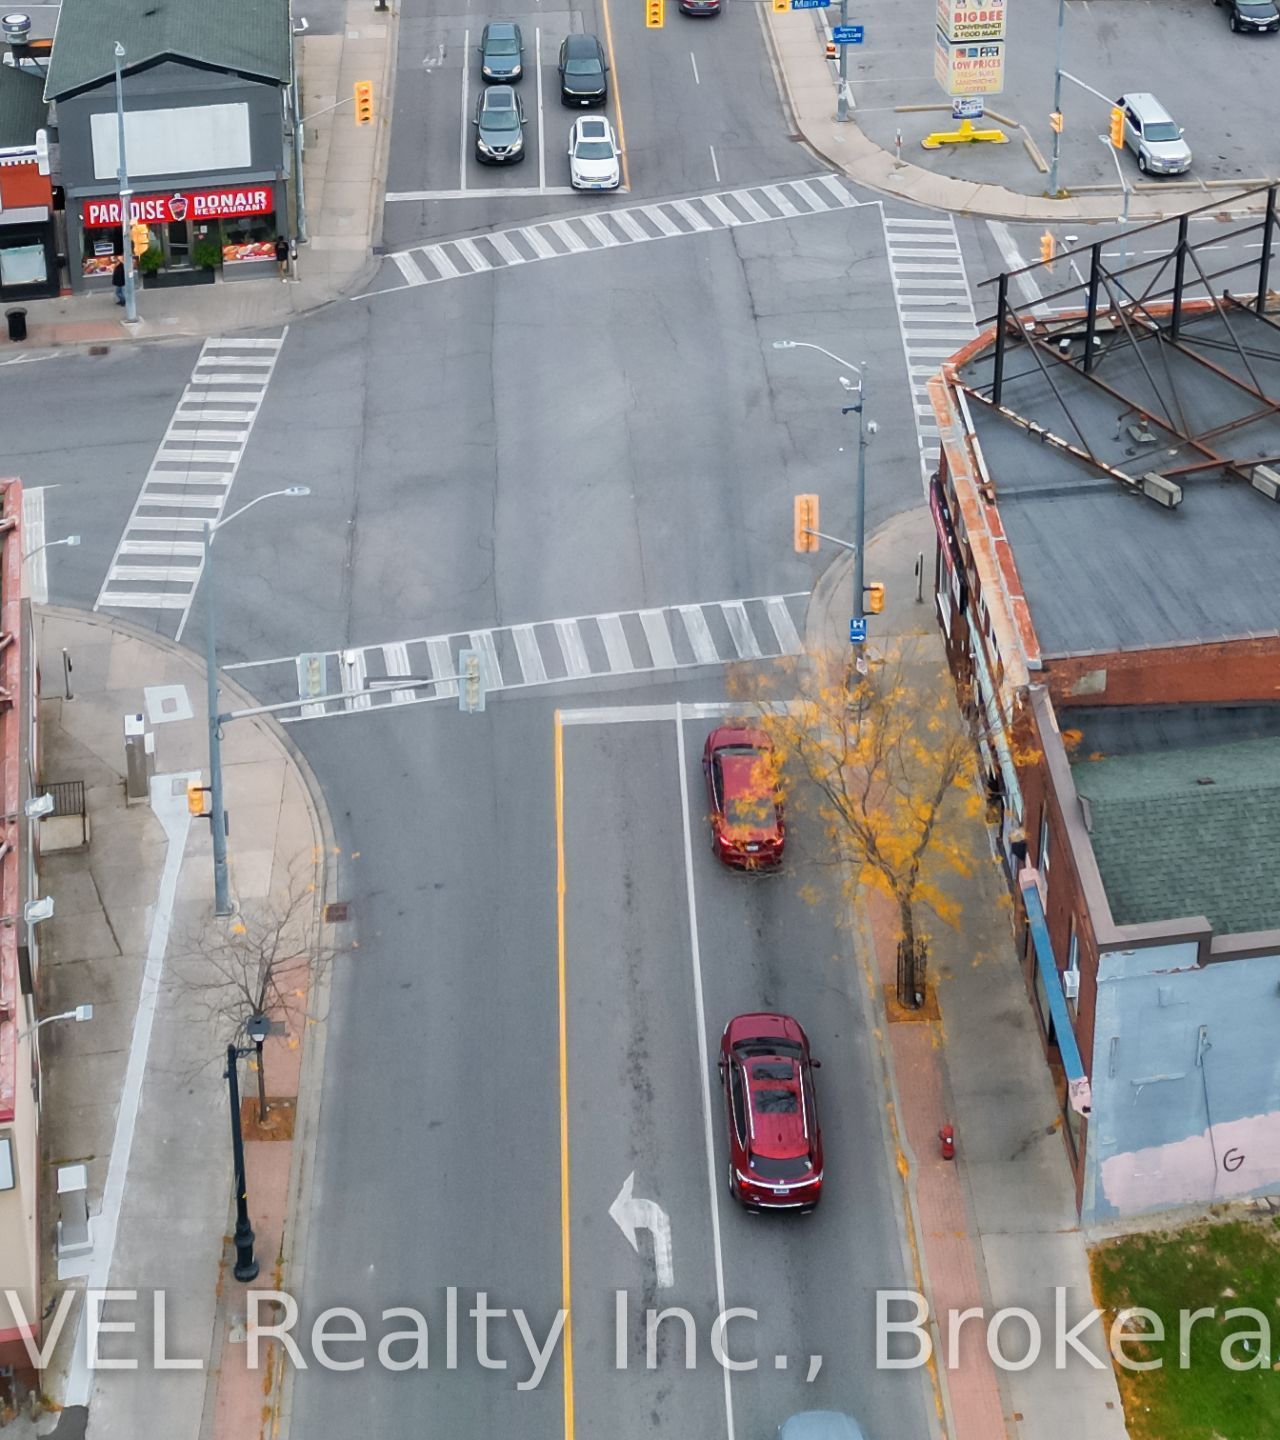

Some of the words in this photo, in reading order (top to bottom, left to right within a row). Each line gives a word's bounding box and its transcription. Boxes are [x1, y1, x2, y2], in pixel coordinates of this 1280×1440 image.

[795, 0, 818, 8] Main
[954, 12, 977, 23] BIG
[980, 10, 1003, 21] BEE
[954, 22, 1001, 31] CONVENIENCE
[953, 61, 972, 70] LOW
[973, 59, 1001, 68] PRICES
[194, 191, 266, 209] DONAIR
[194, 203, 266, 216] RESTAURANT
[853, 620, 864, 628] H
